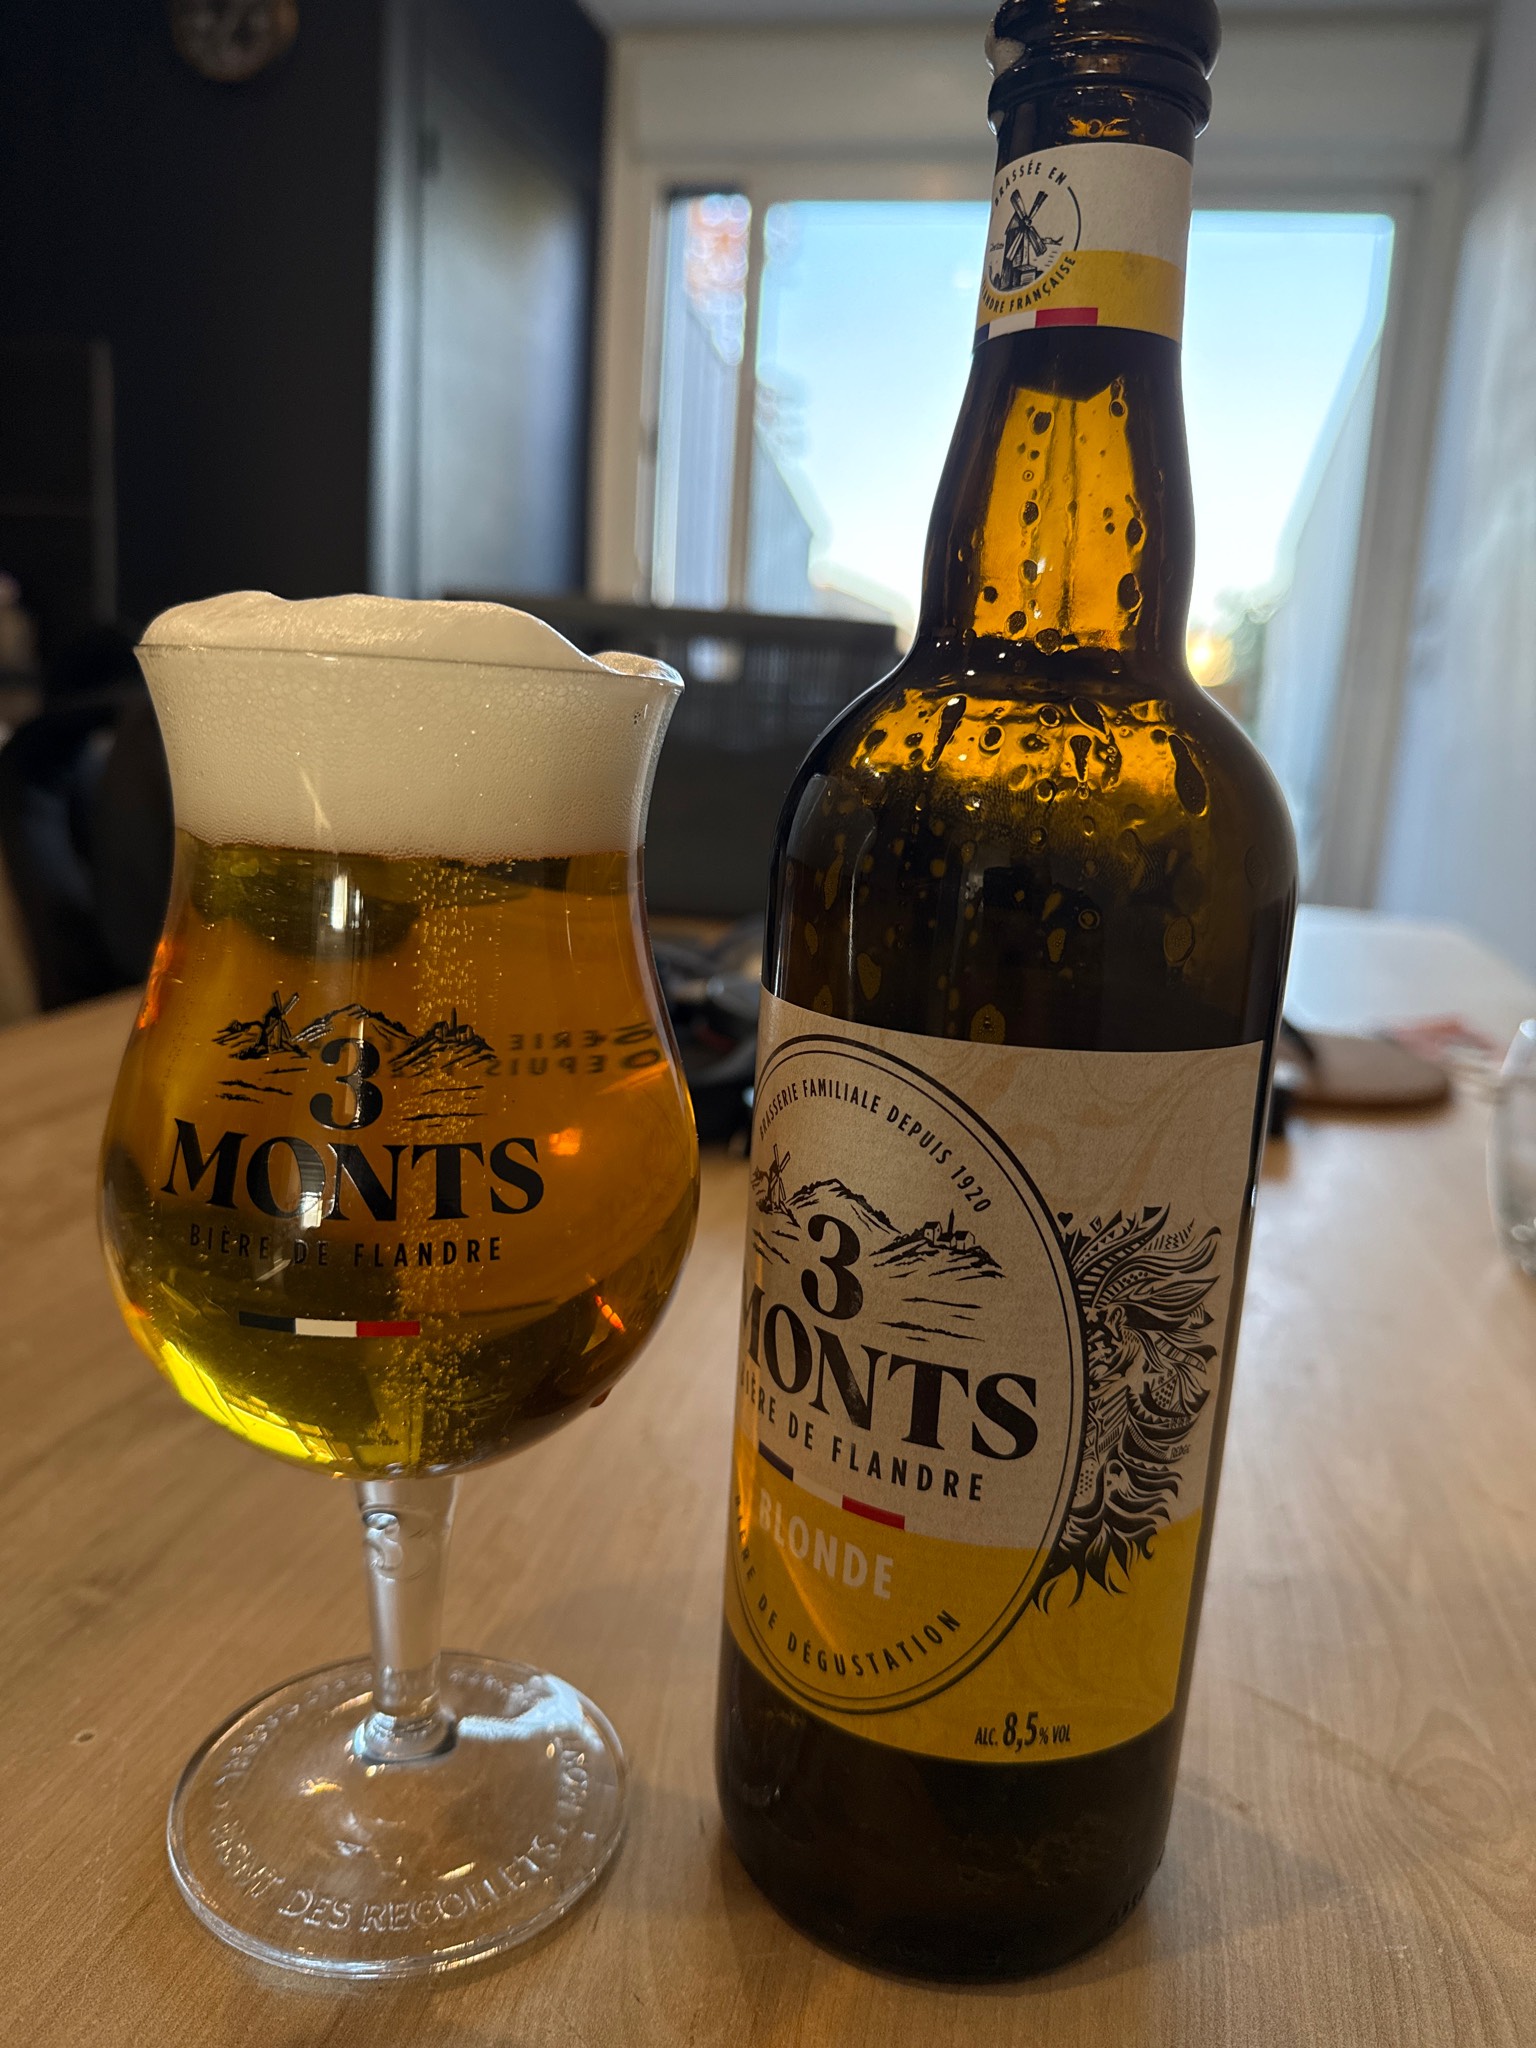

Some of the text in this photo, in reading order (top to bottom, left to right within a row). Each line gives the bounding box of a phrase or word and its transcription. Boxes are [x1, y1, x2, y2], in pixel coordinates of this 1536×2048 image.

[1048, 167, 1067, 186] EN
[1009, 256, 1076, 313] FRANÇAISE
[309, 1037, 384, 1130] 3
[160, 1117, 545, 1222] MONTS
[759, 1078, 993, 1213] BRASSERIE FAMILIALE DEPUIS 1920
[190, 1223, 501, 1268] BIÈRE DE FLANDRE
[800, 1213, 864, 1321] 3
[788, 1410, 815, 1451] DE
[831, 1434, 984, 1502] FLANDRE
[759, 1487, 895, 1601] BLONDE
[757, 1592, 779, 1631] DE
[786, 1608, 962, 1678] DÉGUSTATION
[974, 1726, 999, 1746] ALC.
[1052, 1724, 1071, 1744] VOL
[277, 1888, 353, 1932] DES
